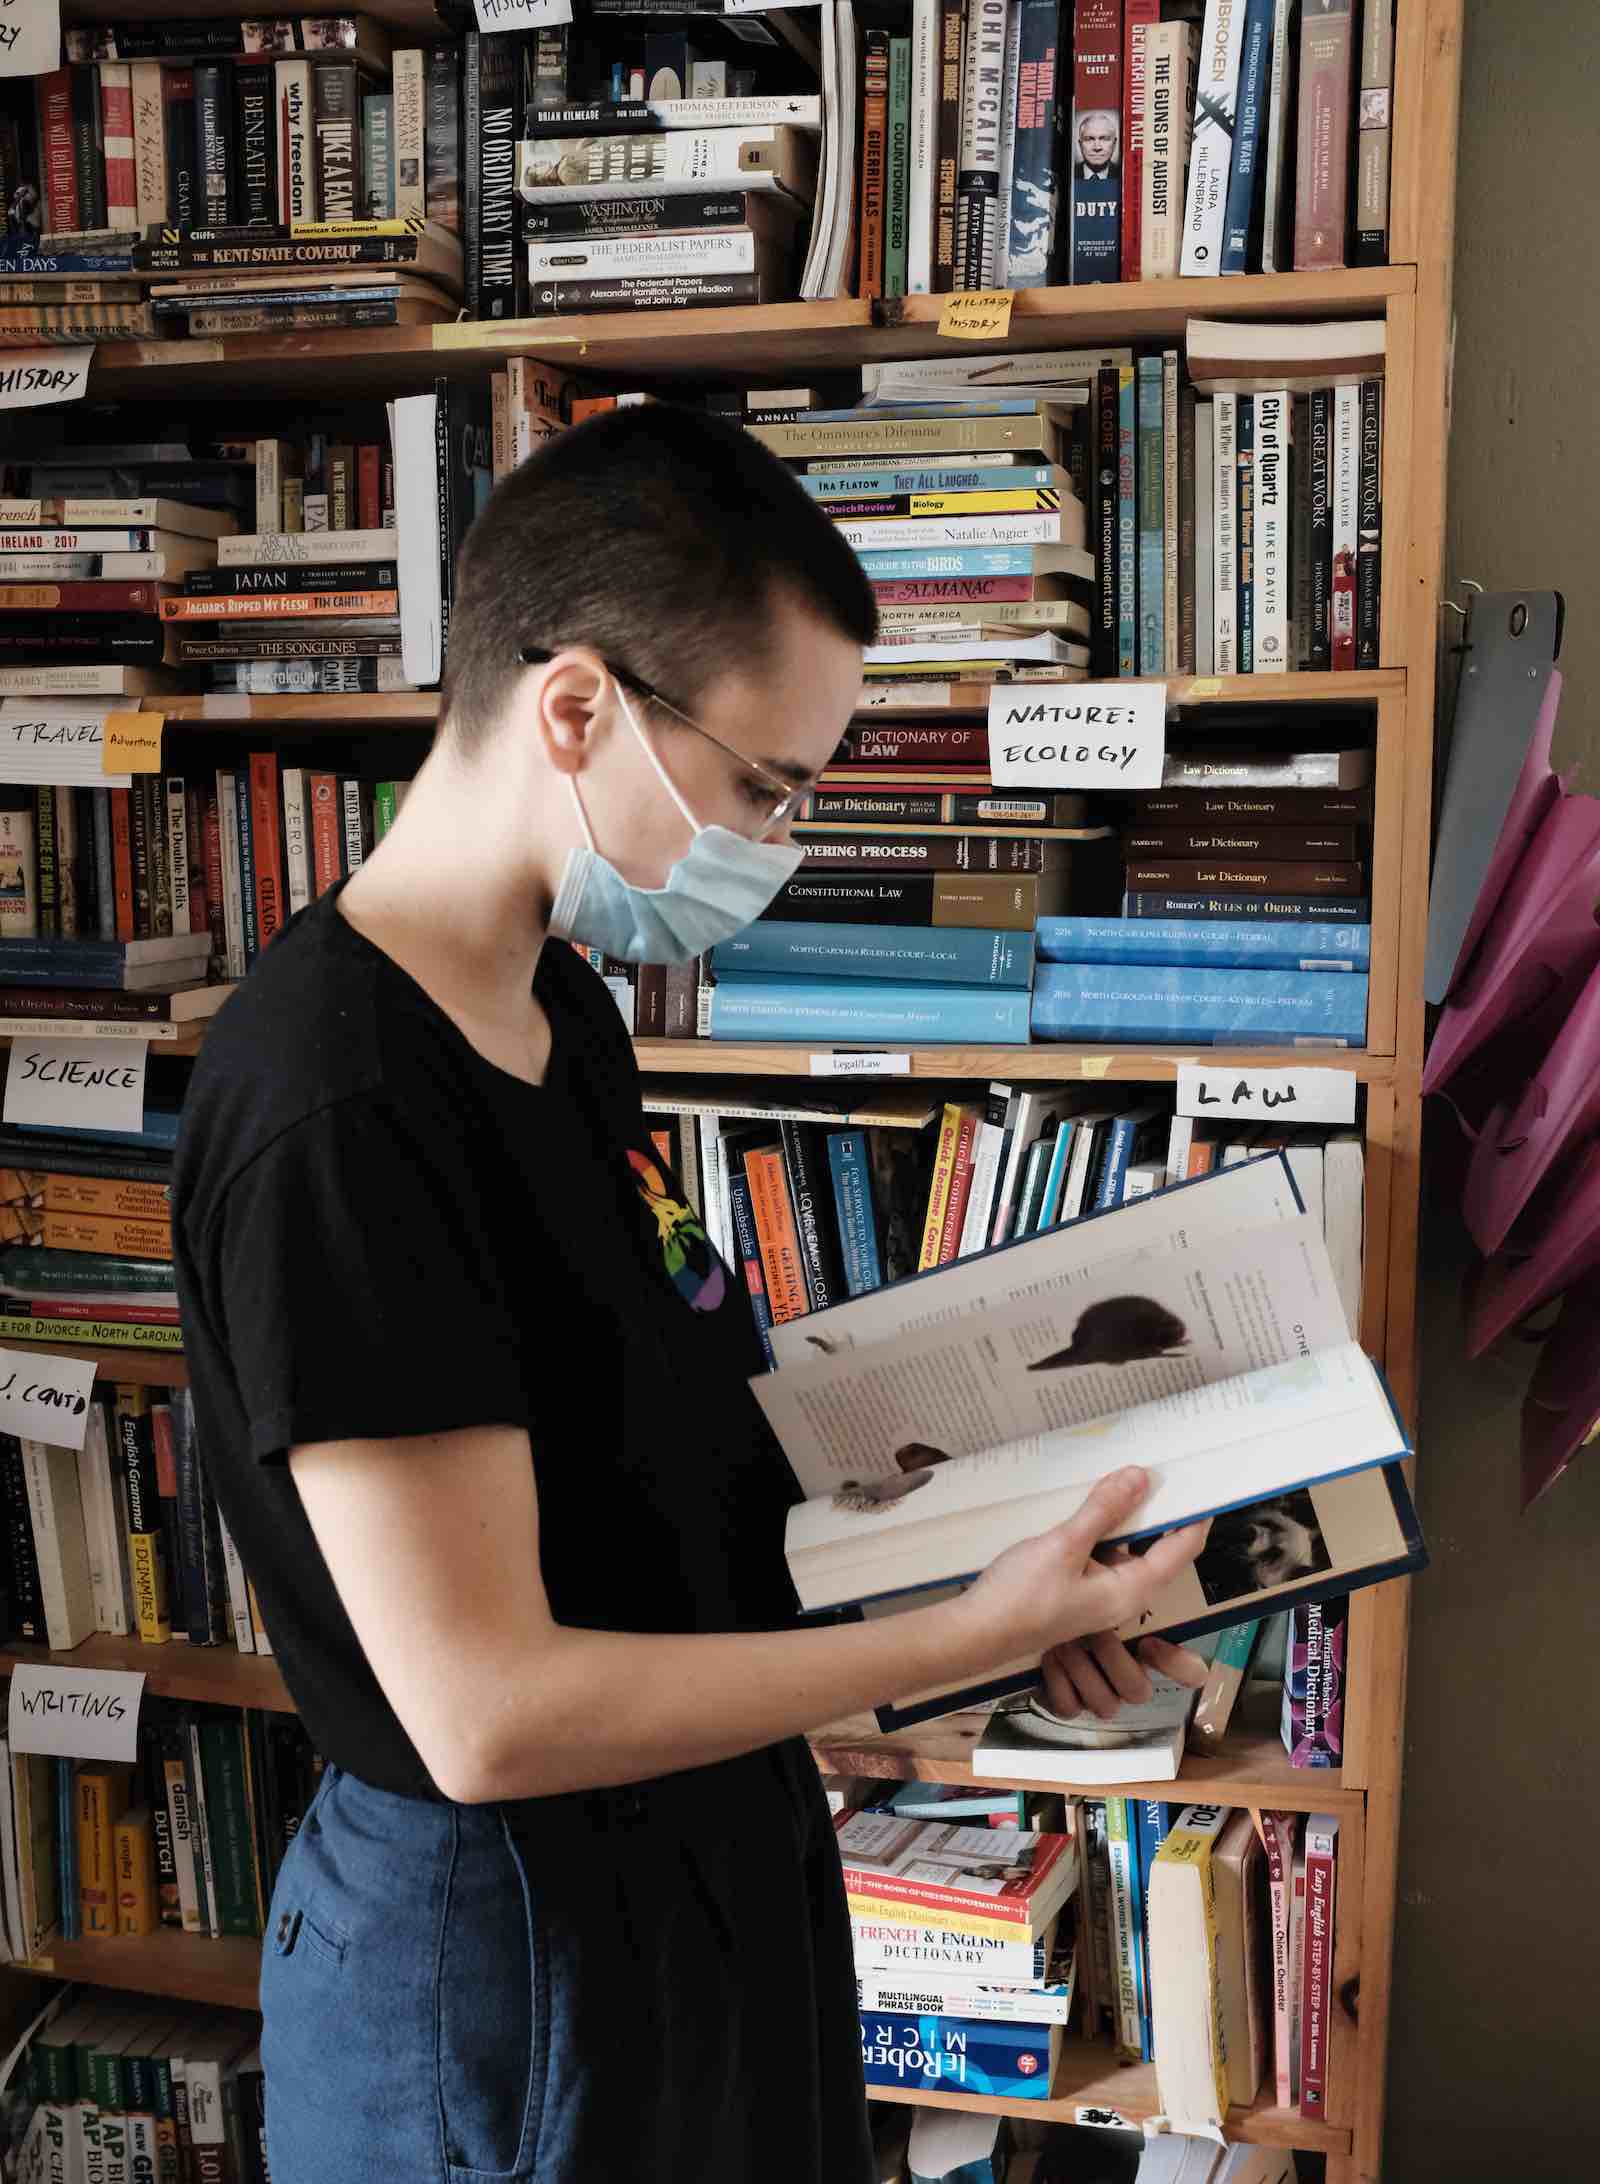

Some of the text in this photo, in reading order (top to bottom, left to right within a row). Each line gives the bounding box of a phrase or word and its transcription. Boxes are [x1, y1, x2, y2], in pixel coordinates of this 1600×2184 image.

[1212, 0, 1233, 82] BROKEN
[964, 32, 977, 148] MARK SALTER
[1239, 36, 1261, 174] INTRODUCTION CIVIL WARS
[244, 95, 266, 187] BENEATH
[289, 82, 304, 217] why freedom
[317, 123, 352, 162] LIKE
[1152, 54, 1170, 217] THE GUNS OF AUGUST
[865, 130, 881, 217] GUERRILLAS
[483, 107, 512, 288] NO ORDINARY TIME
[1191, 146, 1209, 232] HILLENBRAND
[1207, 168, 1222, 210] LAURA
[578, 199, 665, 218] WASHINGTON
[969, 202, 982, 235] FAITH
[1076, 201, 1118, 218] DUTY
[294, 224, 378, 234] American Government
[213, 244, 361, 263] KENT STATE COVERUP
[614, 239, 733, 254] FEDERALIST PAPERS
[22, 257, 57, 272] DAYS
[590, 285, 733, 299] Alexander Hamilton, James Madison
[620, 277, 703, 288] The Federalist Papers
[635, 296, 687, 306] and John Jay
[1259, 398, 1280, 506] City of Quartz
[1312, 399, 1327, 529] THE GREAT WORK
[1363, 392, 1377, 526] THE GREAT WORK
[819, 480, 880, 492] IRA FLATOW
[894, 473, 936, 491] THEY ALL
[913, 500, 945, 511] Biology
[945, 528, 987, 541] Natalie
[990, 527, 1029, 542] Angier
[1220, 514, 1232, 531] with
[1, 535, 78, 549] IRELAND 2017
[1104, 500, 1114, 630] an inconvenient truth
[1119, 518, 1135, 623] OUR CHOICE
[1265, 521, 1277, 615] MIKE DAVIS
[234, 571, 288, 590] JAPAN
[899, 580, 996, 600] ALMANAC
[185, 596, 309, 614] JAGUARS RIPPED MY FLESH
[882, 610, 962, 621] NORTH AMERICA
[257, 641, 357, 655] THE SONGLINES
[325, 661, 340, 691] INTO
[343, 661, 358, 691] THIN
[1005, 703, 1137, 725] NATURE:
[13, 721, 103, 744] TRAVEL
[861, 730, 971, 745] DICTIONARY OF
[860, 743, 899, 757] LAW
[1002, 744, 1137, 769] ECOLOGY
[1184, 764, 1250, 778] Law Dictionary
[347, 789, 361, 838] INTO THE
[817, 797, 906, 815] Law Dictionary
[1205, 801, 1276, 813] Law Dictionary
[286, 802, 304, 856] ZERO
[1189, 837, 1260, 850] Law Dictionary
[171, 806, 187, 910] The Double Helix
[860, 844, 928, 858] PROCESS
[788, 884, 903, 899] CONSTITUTIONAL LAW
[1197, 870, 1269, 885] Law Dictionary
[261, 877, 277, 937] CHAOS
[1208, 900, 1302, 914] RULES ORDER
[20, 1052, 140, 1089] SCIENCE
[832, 1057, 882, 1072] Legal/Law
[1198, 1080, 1297, 1108] LAW
[954, 1126, 971, 1177] crucial
[924, 1127, 954, 1264] Quick Resume Cover
[732, 1188, 753, 1256] Unsubscribe
[11, 1322, 31, 1334] FOR
[35, 1320, 82, 1336] DIVORCE
[91, 1324, 129, 1340] NORTH
[124, 1420, 144, 1532] English Grammar
[135, 1547, 154, 1623] DUMMIES
[1303, 1600, 1322, 1741] Medical Dictionary
[1323, 1626, 1335, 1720] Merriam-Webster's
[21, 1689, 127, 1721] WRITING
[172, 1782, 190, 1841] danish
[154, 1810, 174, 1874] DUTCH
[1310, 1867, 1327, 1937] Easy English
[859, 1925, 1005, 1950] FRENCH & ENGLISH
[883, 1944, 985, 1964] DICTIONARY
[1275, 1930, 1288, 2012] Chinese Character
[877, 1991, 944, 2004] MULTILINGUAL
[877, 2001, 944, 2013] PHRASE BOOK
[1120, 1967, 1135, 2017] TOEFL
[861, 2023, 968, 2053] MICR
[45, 2109, 64, 2151] AP
[82, 2110, 101, 2147] AP
[103, 2124, 126, 2159] AP
[134, 2122, 145, 2151] NEW
